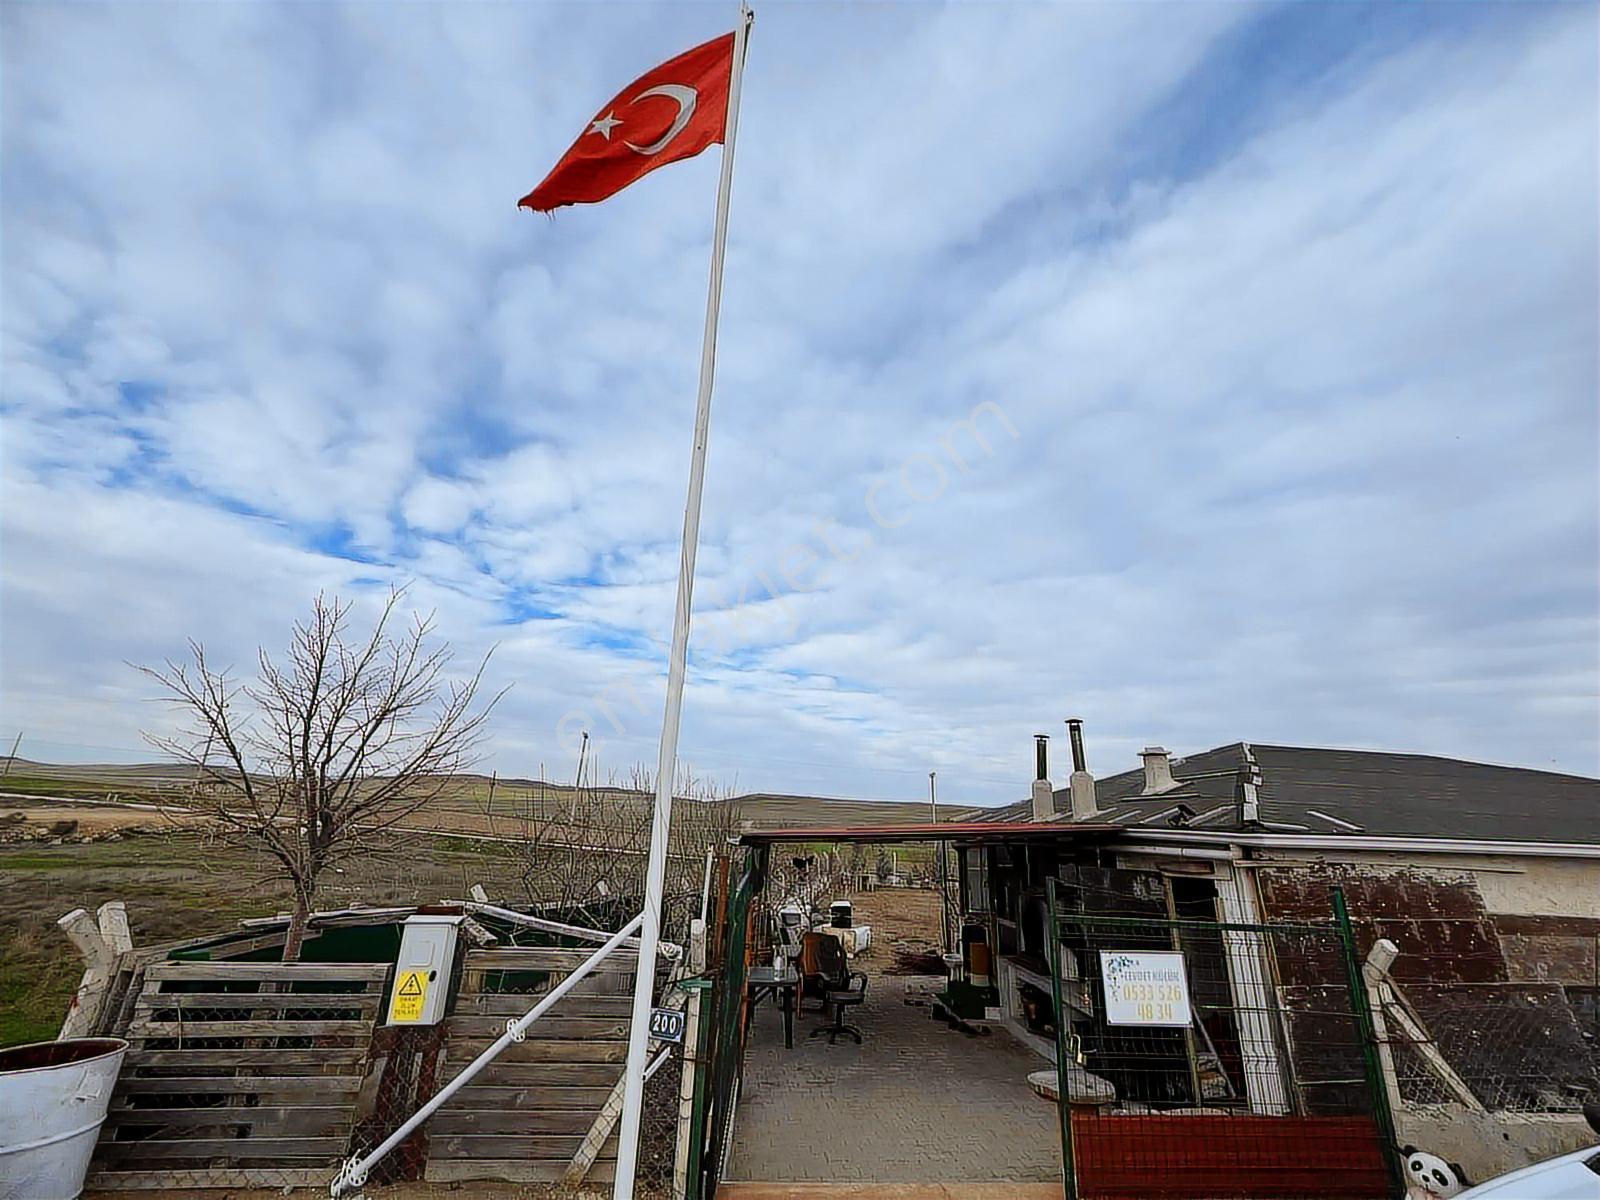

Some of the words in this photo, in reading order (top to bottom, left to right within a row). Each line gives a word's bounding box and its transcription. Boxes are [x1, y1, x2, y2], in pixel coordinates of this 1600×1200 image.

[1123, 984, 1154, 1001] 0533
[1158, 984, 1182, 1001] 526
[652, 1014, 677, 1034] 200
